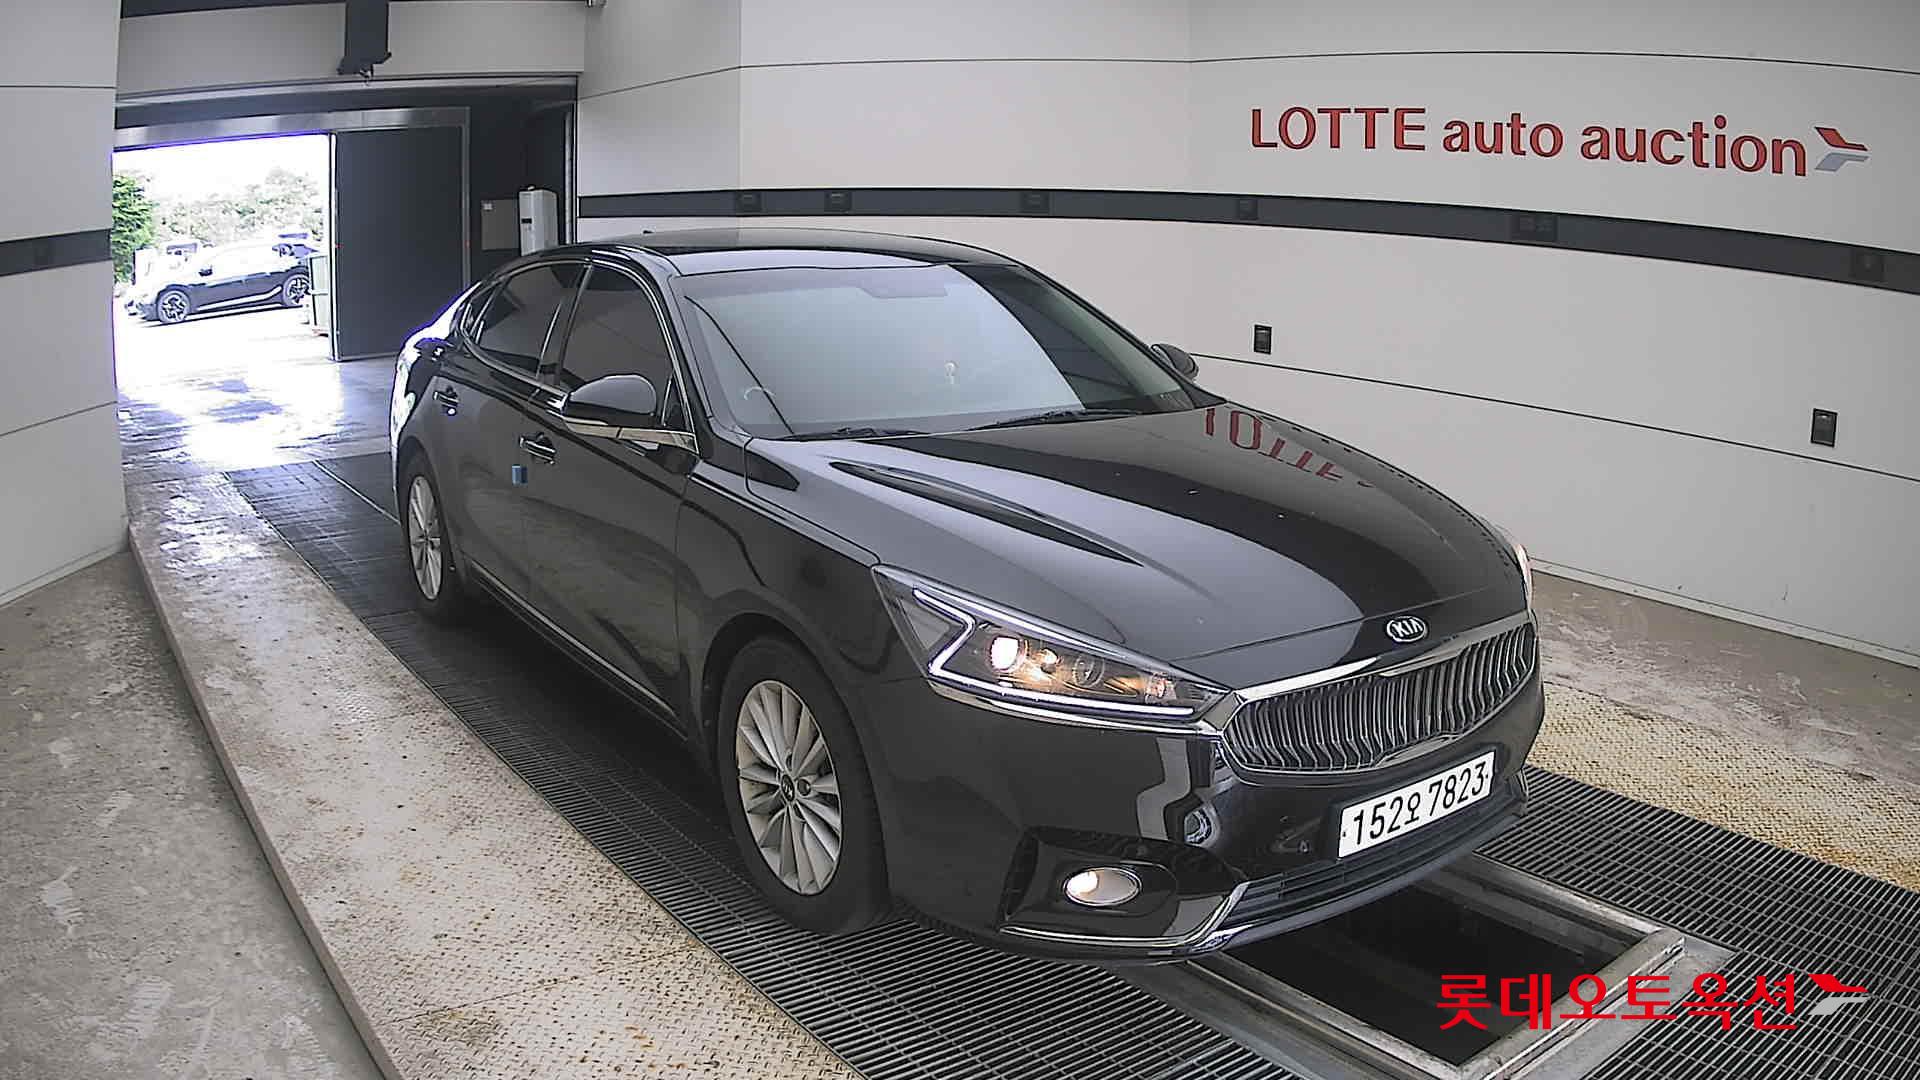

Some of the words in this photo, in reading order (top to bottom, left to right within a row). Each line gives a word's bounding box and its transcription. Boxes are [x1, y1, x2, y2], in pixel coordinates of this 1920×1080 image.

[1250, 106, 1426, 151] LOTTE
[1442, 113, 1564, 157] auto
[1580, 115, 1807, 177] auction
[1391, 618, 1423, 637] KIA
[1353, 792, 1421, 845] 152오
[1428, 761, 1486, 817] 7823
